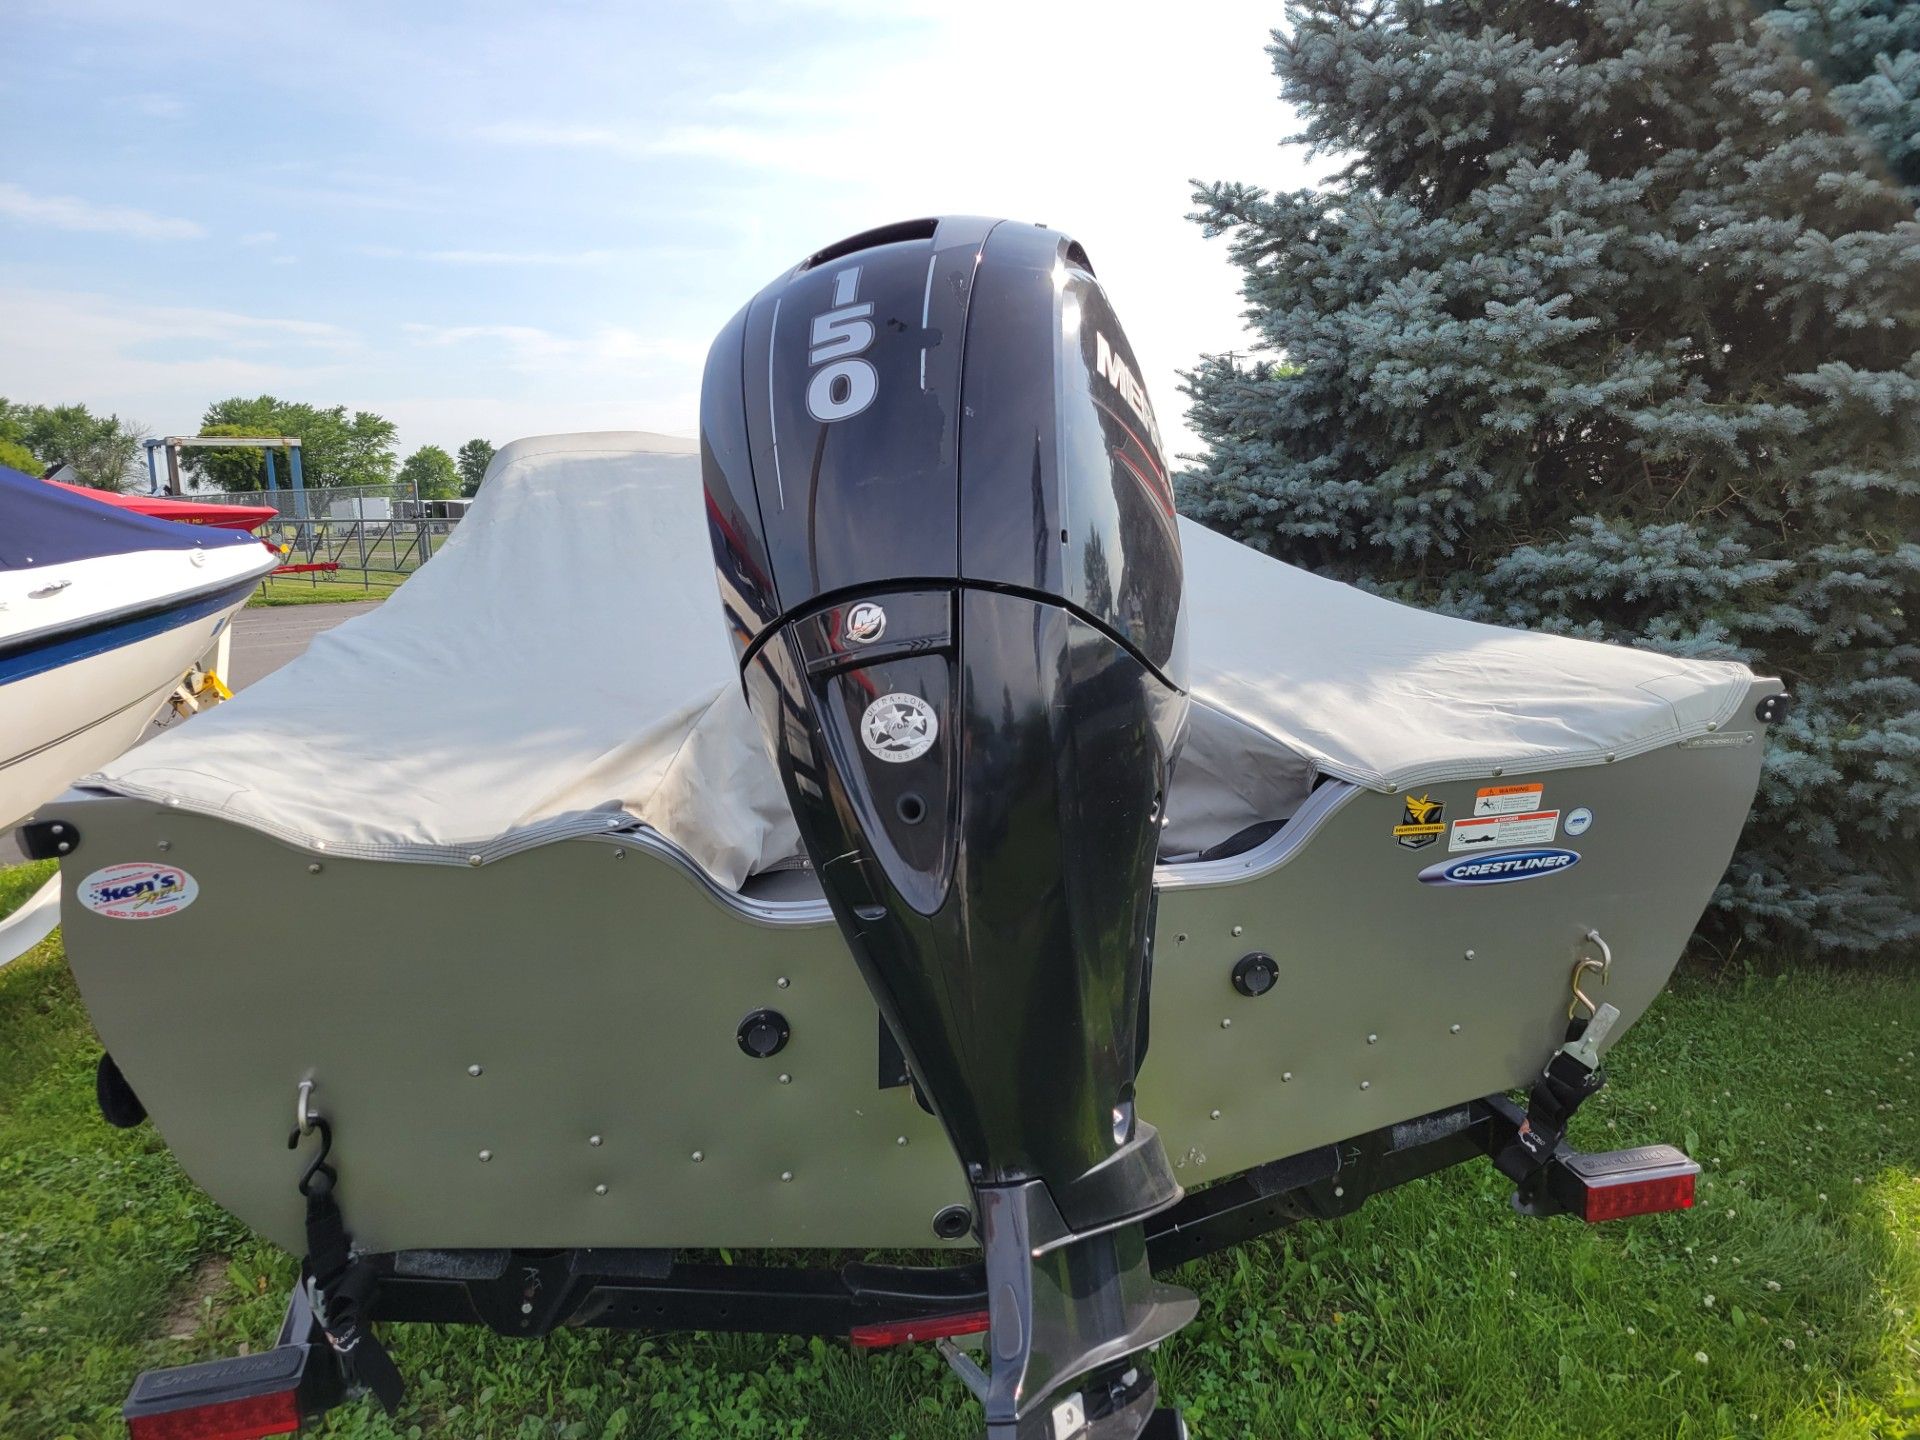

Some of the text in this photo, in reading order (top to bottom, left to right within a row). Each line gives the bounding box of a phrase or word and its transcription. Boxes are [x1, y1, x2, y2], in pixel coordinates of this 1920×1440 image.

[806, 266, 879, 423] 150
[866, 695, 926, 717] ULTRA LOW
[877, 742, 930, 760] EMISSION
[1499, 785, 1530, 794] WARNING
[1452, 855, 1570, 877] CRESTLINER
